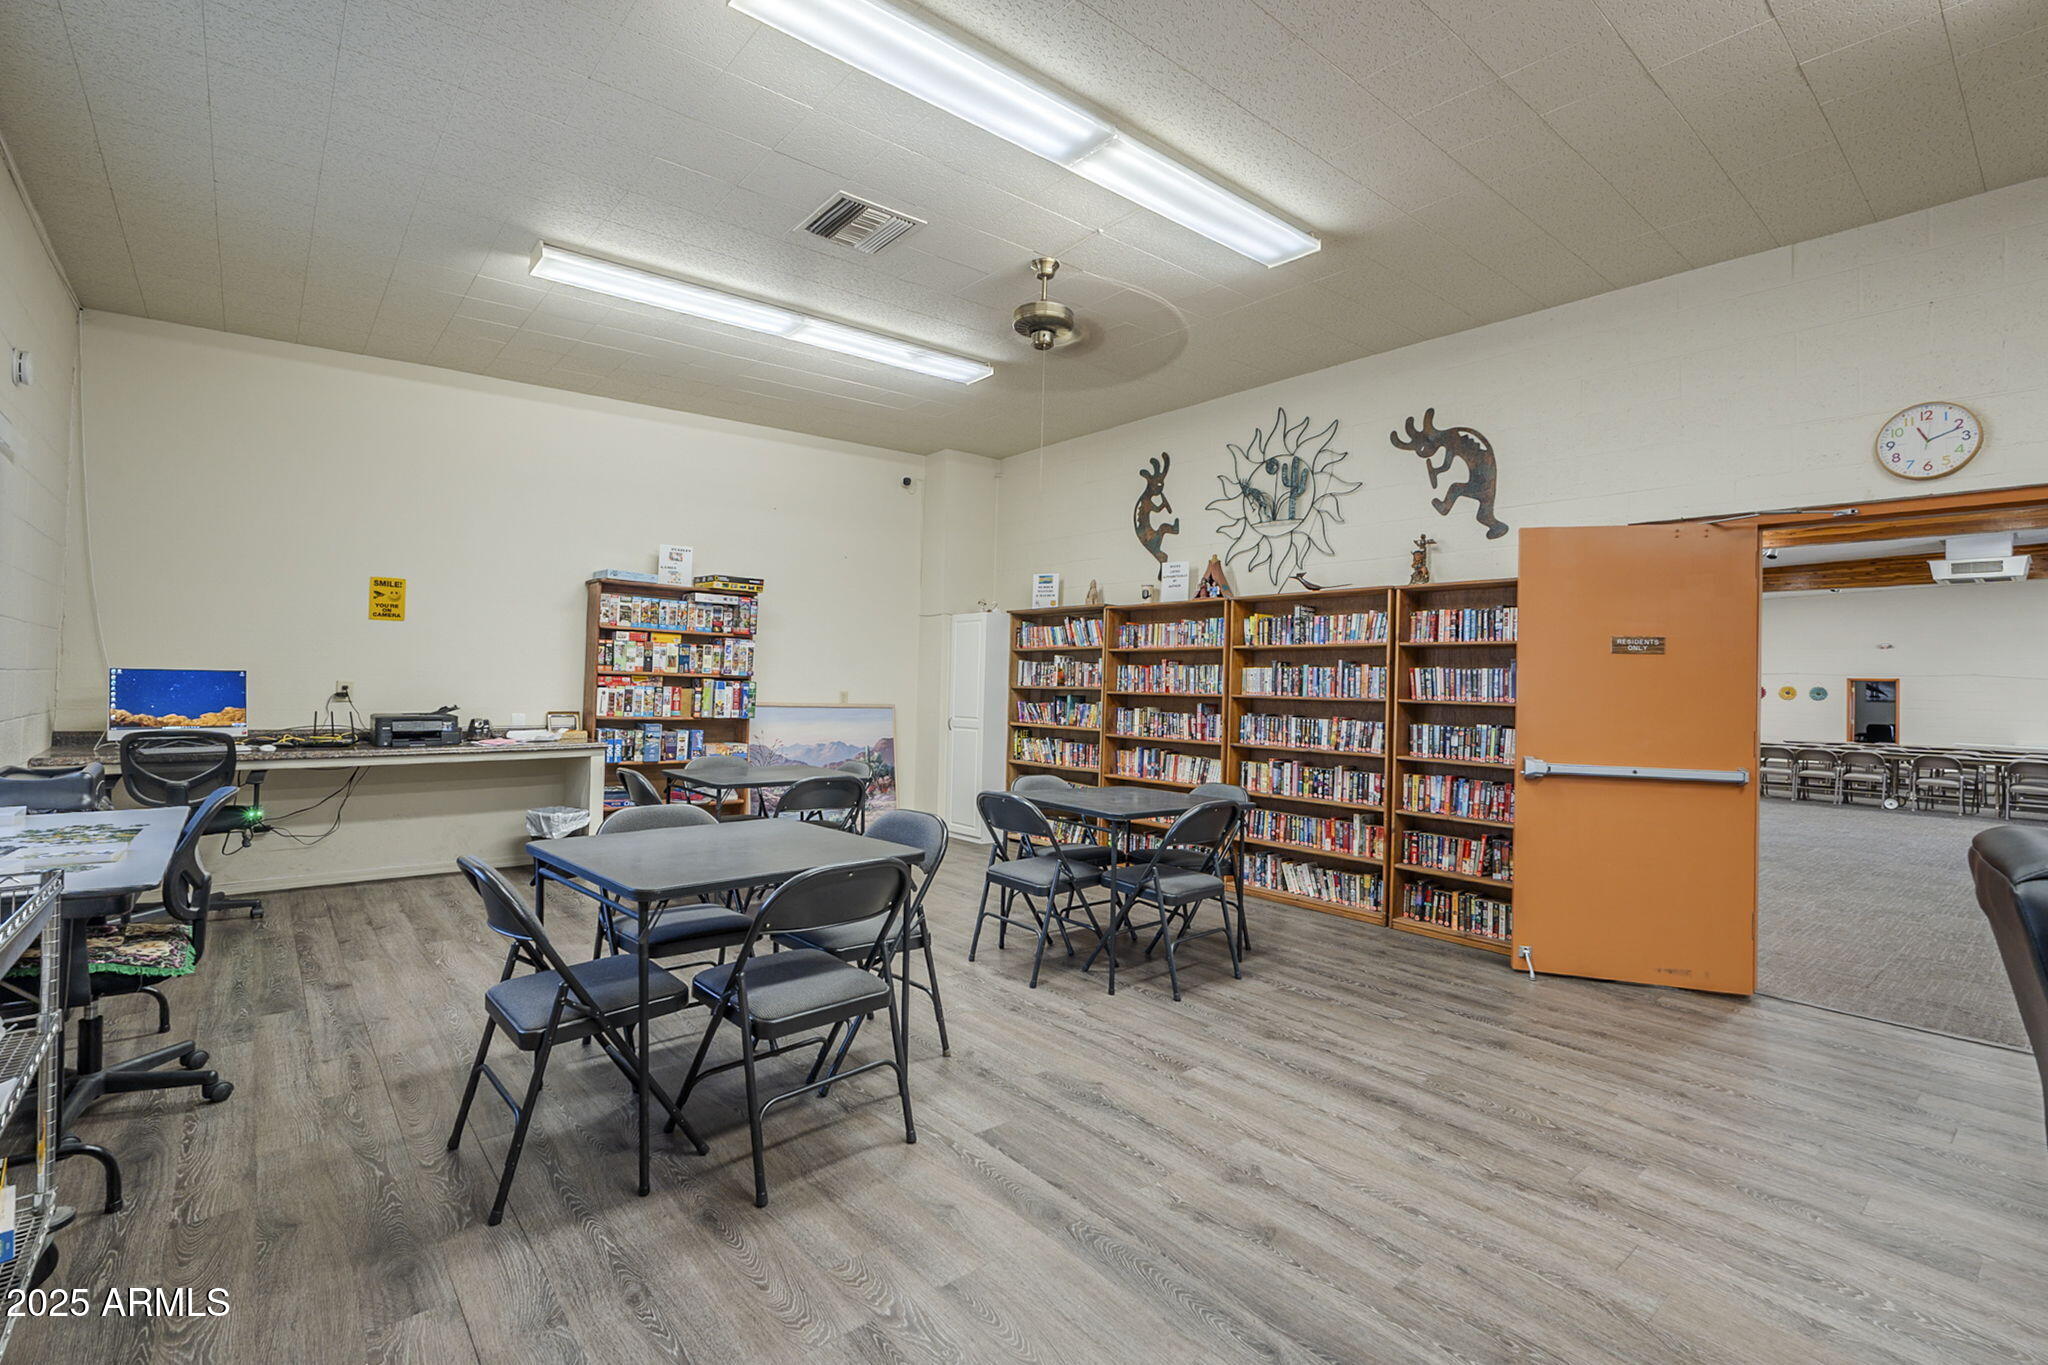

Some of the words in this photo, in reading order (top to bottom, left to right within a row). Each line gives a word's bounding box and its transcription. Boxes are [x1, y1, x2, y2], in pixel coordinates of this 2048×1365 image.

[1920, 410, 1933, 421] 12
[1944, 411, 1948, 421] 1
[1904, 417, 1914, 427] 11
[1954, 418, 1964, 429] 2
[1891, 427, 1904, 438] 10
[1961, 430, 1971, 441] 3
[1886, 441, 1895, 451] 9
[1954, 444, 1964, 453] 4
[1891, 453, 1901, 463] 8
[1941, 455, 1951, 466] 5
[1906, 460, 1915, 470] 7
[1923, 461, 1933, 471] 6
[373, 580, 403, 588] SMILE!
